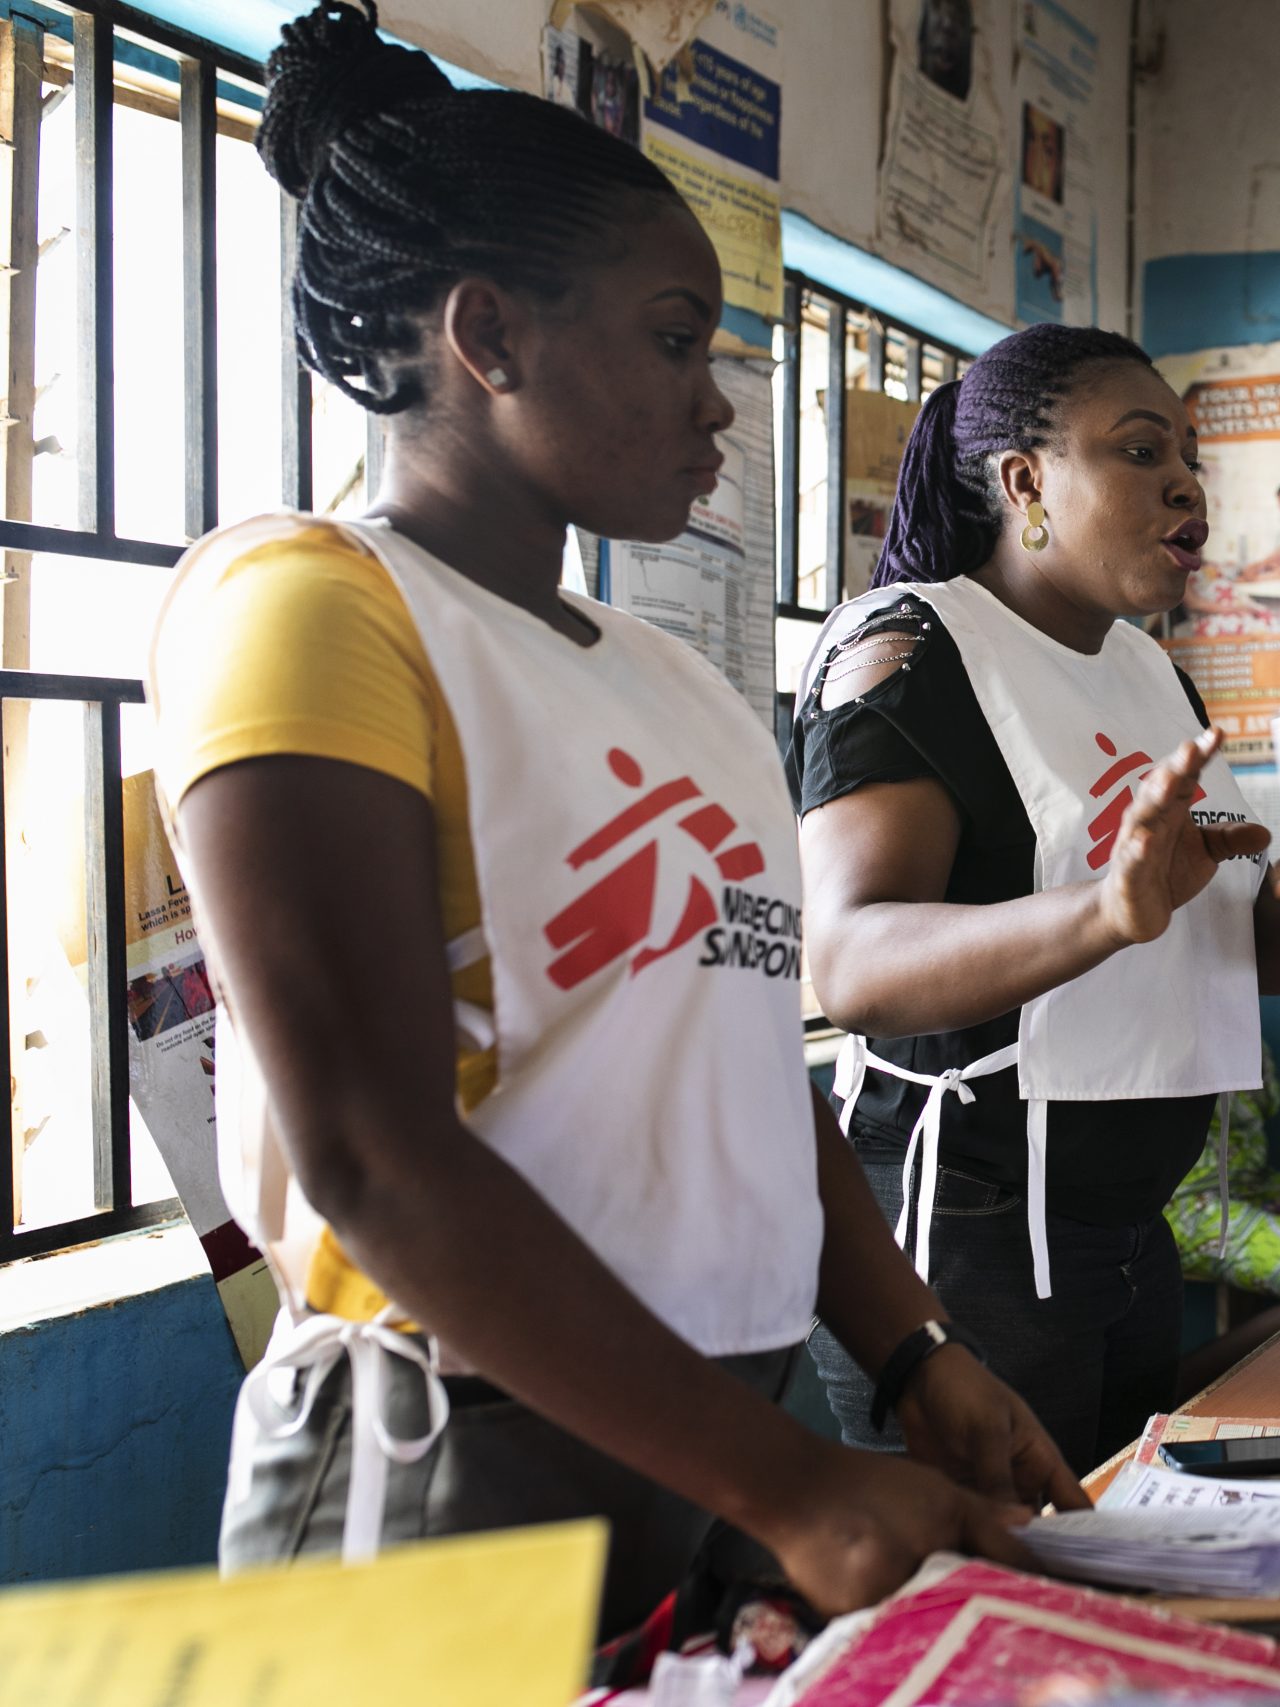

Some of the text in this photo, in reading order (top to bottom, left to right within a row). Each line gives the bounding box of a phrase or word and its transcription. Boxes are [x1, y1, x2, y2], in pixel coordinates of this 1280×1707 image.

[138, 895, 190, 922] Lassa Feve
[141, 915, 169, 932] which
